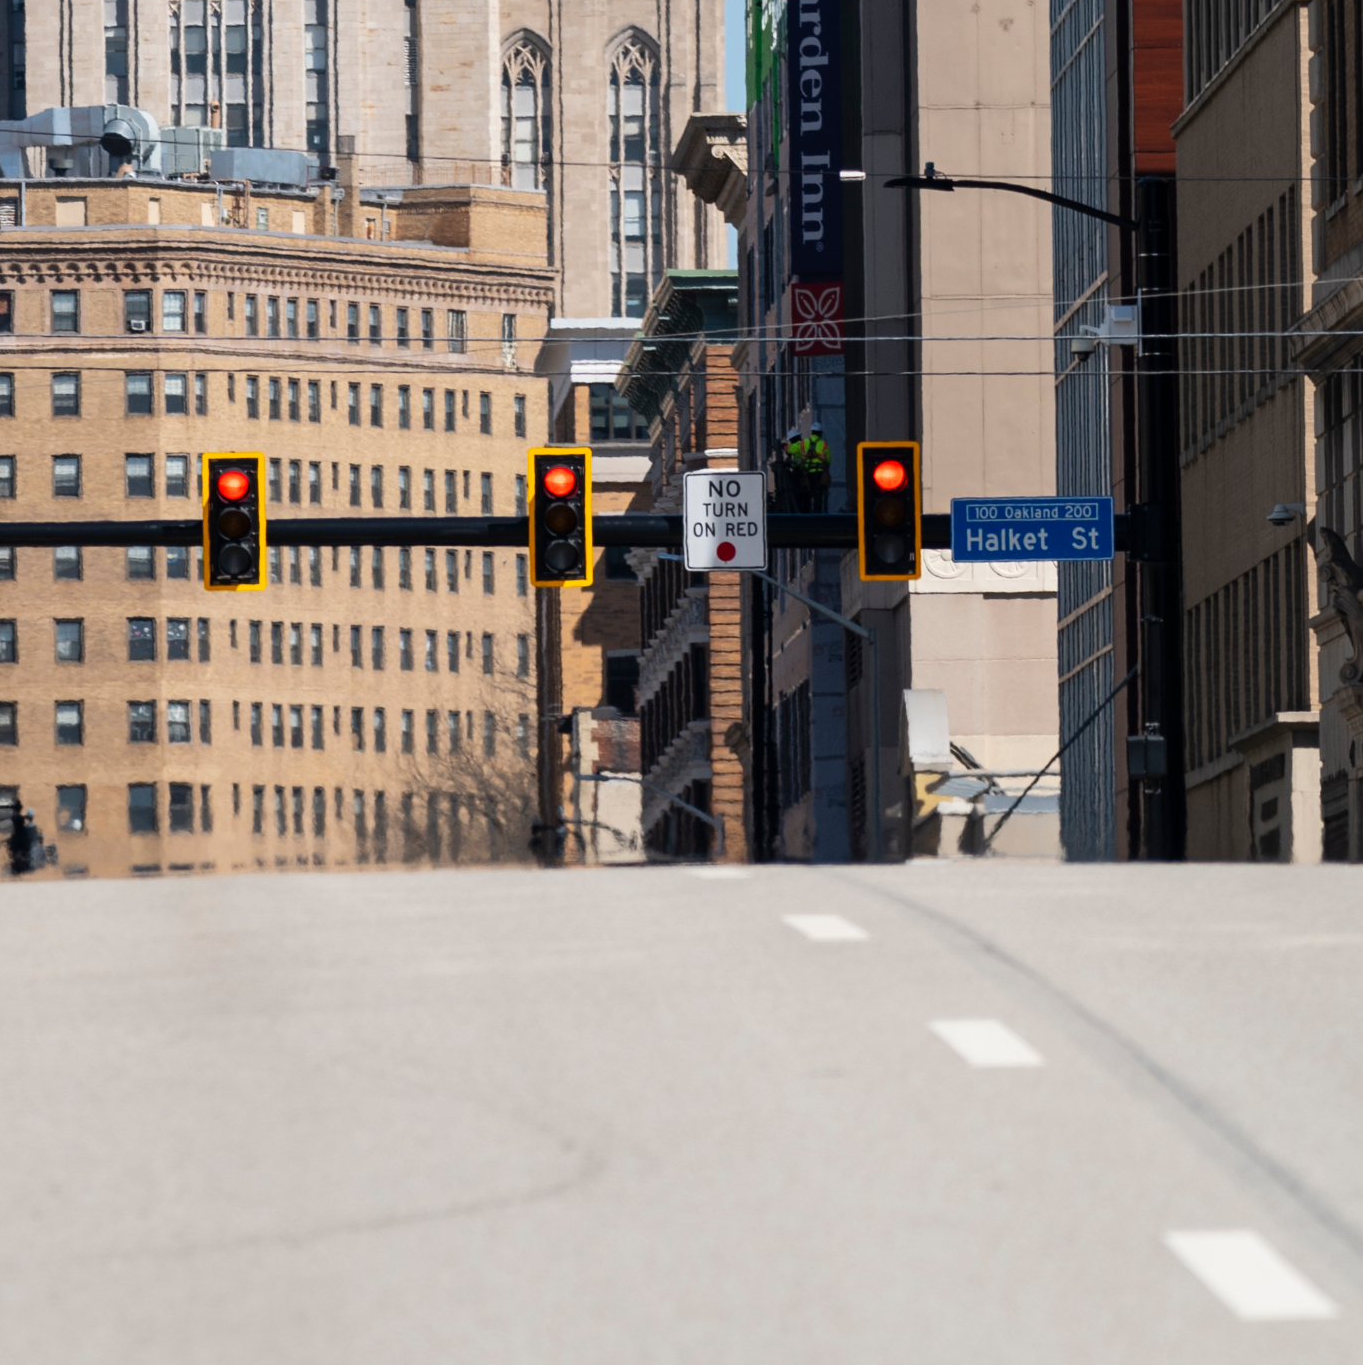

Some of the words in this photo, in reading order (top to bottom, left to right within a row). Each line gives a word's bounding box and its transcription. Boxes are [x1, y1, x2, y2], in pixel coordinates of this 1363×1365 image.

[708, 479, 741, 498] NO
[702, 501, 749, 518] TURN
[975, 506, 998, 519] 100
[1005, 506, 1059, 519] Oakland
[1065, 505, 1092, 518] 200
[693, 521, 716, 538] ON
[725, 521, 759, 537] RED
[966, 527, 1049, 552] Halket
[1072, 526, 1100, 550] St
